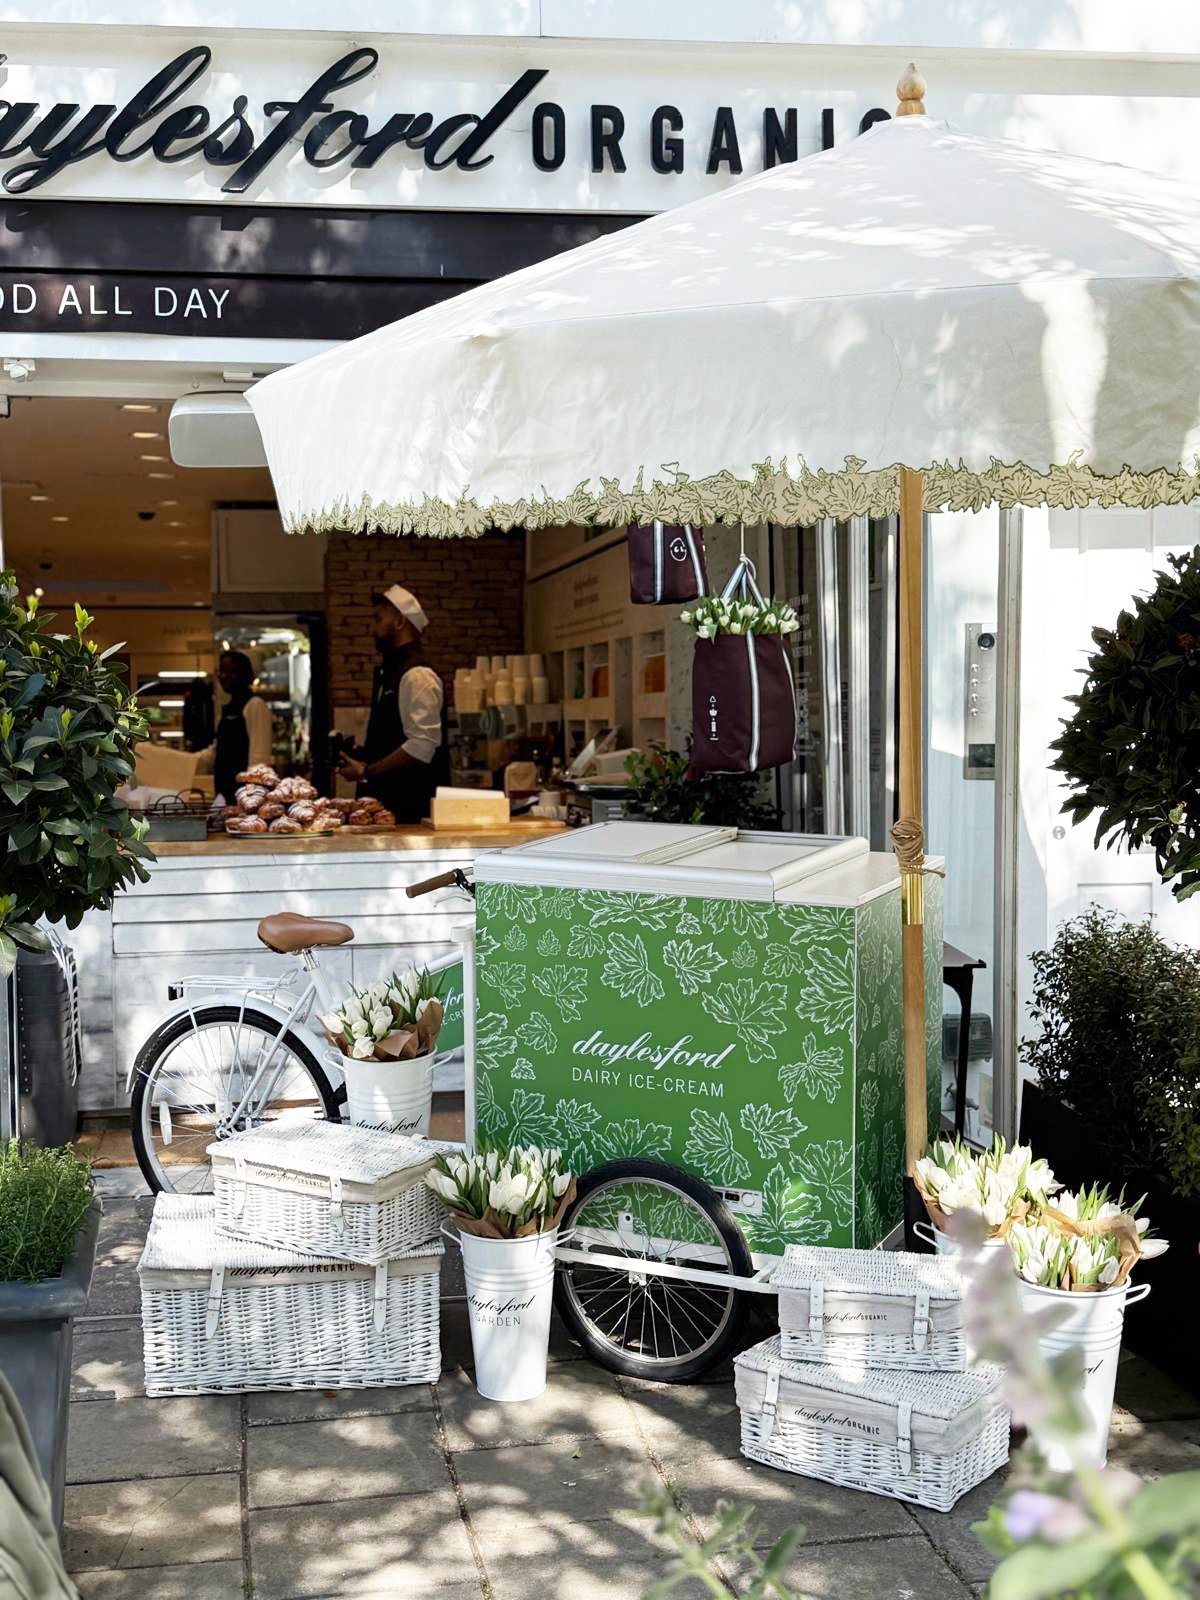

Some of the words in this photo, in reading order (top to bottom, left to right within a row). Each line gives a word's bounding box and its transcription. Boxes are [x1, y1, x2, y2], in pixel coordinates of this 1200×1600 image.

[0, 46, 549, 193] aylesford
[0, 283, 37, 314] D
[58, 284, 133, 315] ALL
[154, 287, 230, 319] DAY
[572, 1030, 737, 1070] daylesford
[572, 1067, 621, 1086] DAIRY
[628, 1074, 724, 1098] ICE-CREAM
[468, 1294, 536, 1316] daylesford
[475, 1312, 521, 1327] GARDEN
[823, 1312, 862, 1323] aylesford
[794, 1407, 849, 1425] daylesford
[846, 1420, 881, 1436] ORGANIC
